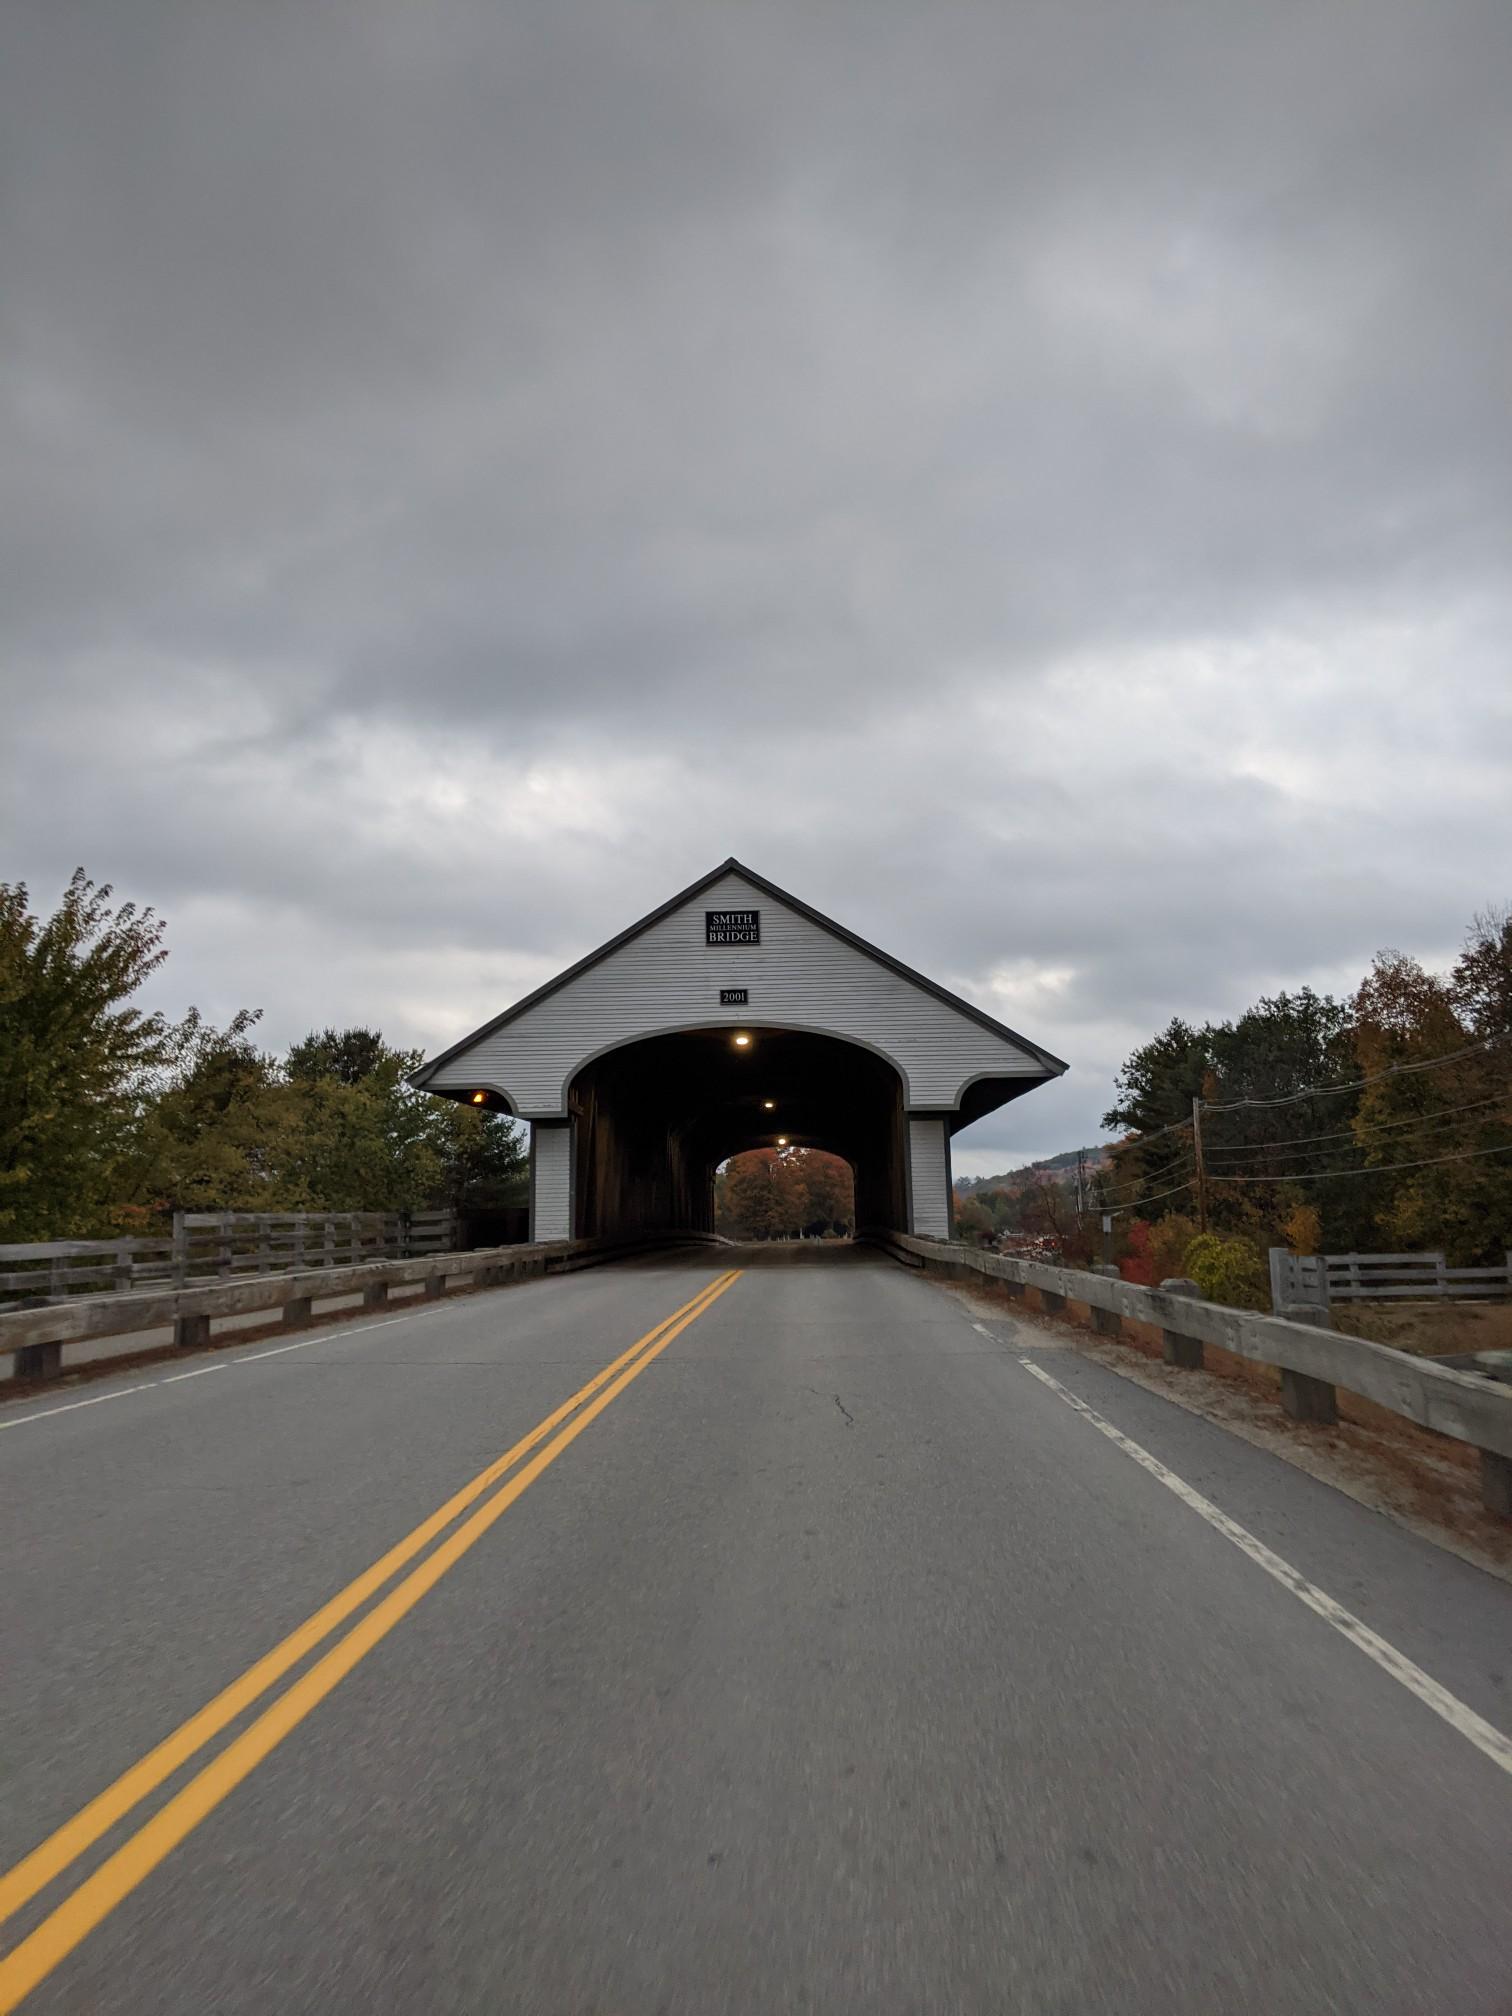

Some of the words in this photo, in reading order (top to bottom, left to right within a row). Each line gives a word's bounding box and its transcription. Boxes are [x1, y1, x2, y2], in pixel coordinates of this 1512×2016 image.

[713, 914, 752, 925] SMITH
[709, 931, 758, 942] BRIDGE
[723, 992, 745, 1002] 2001
